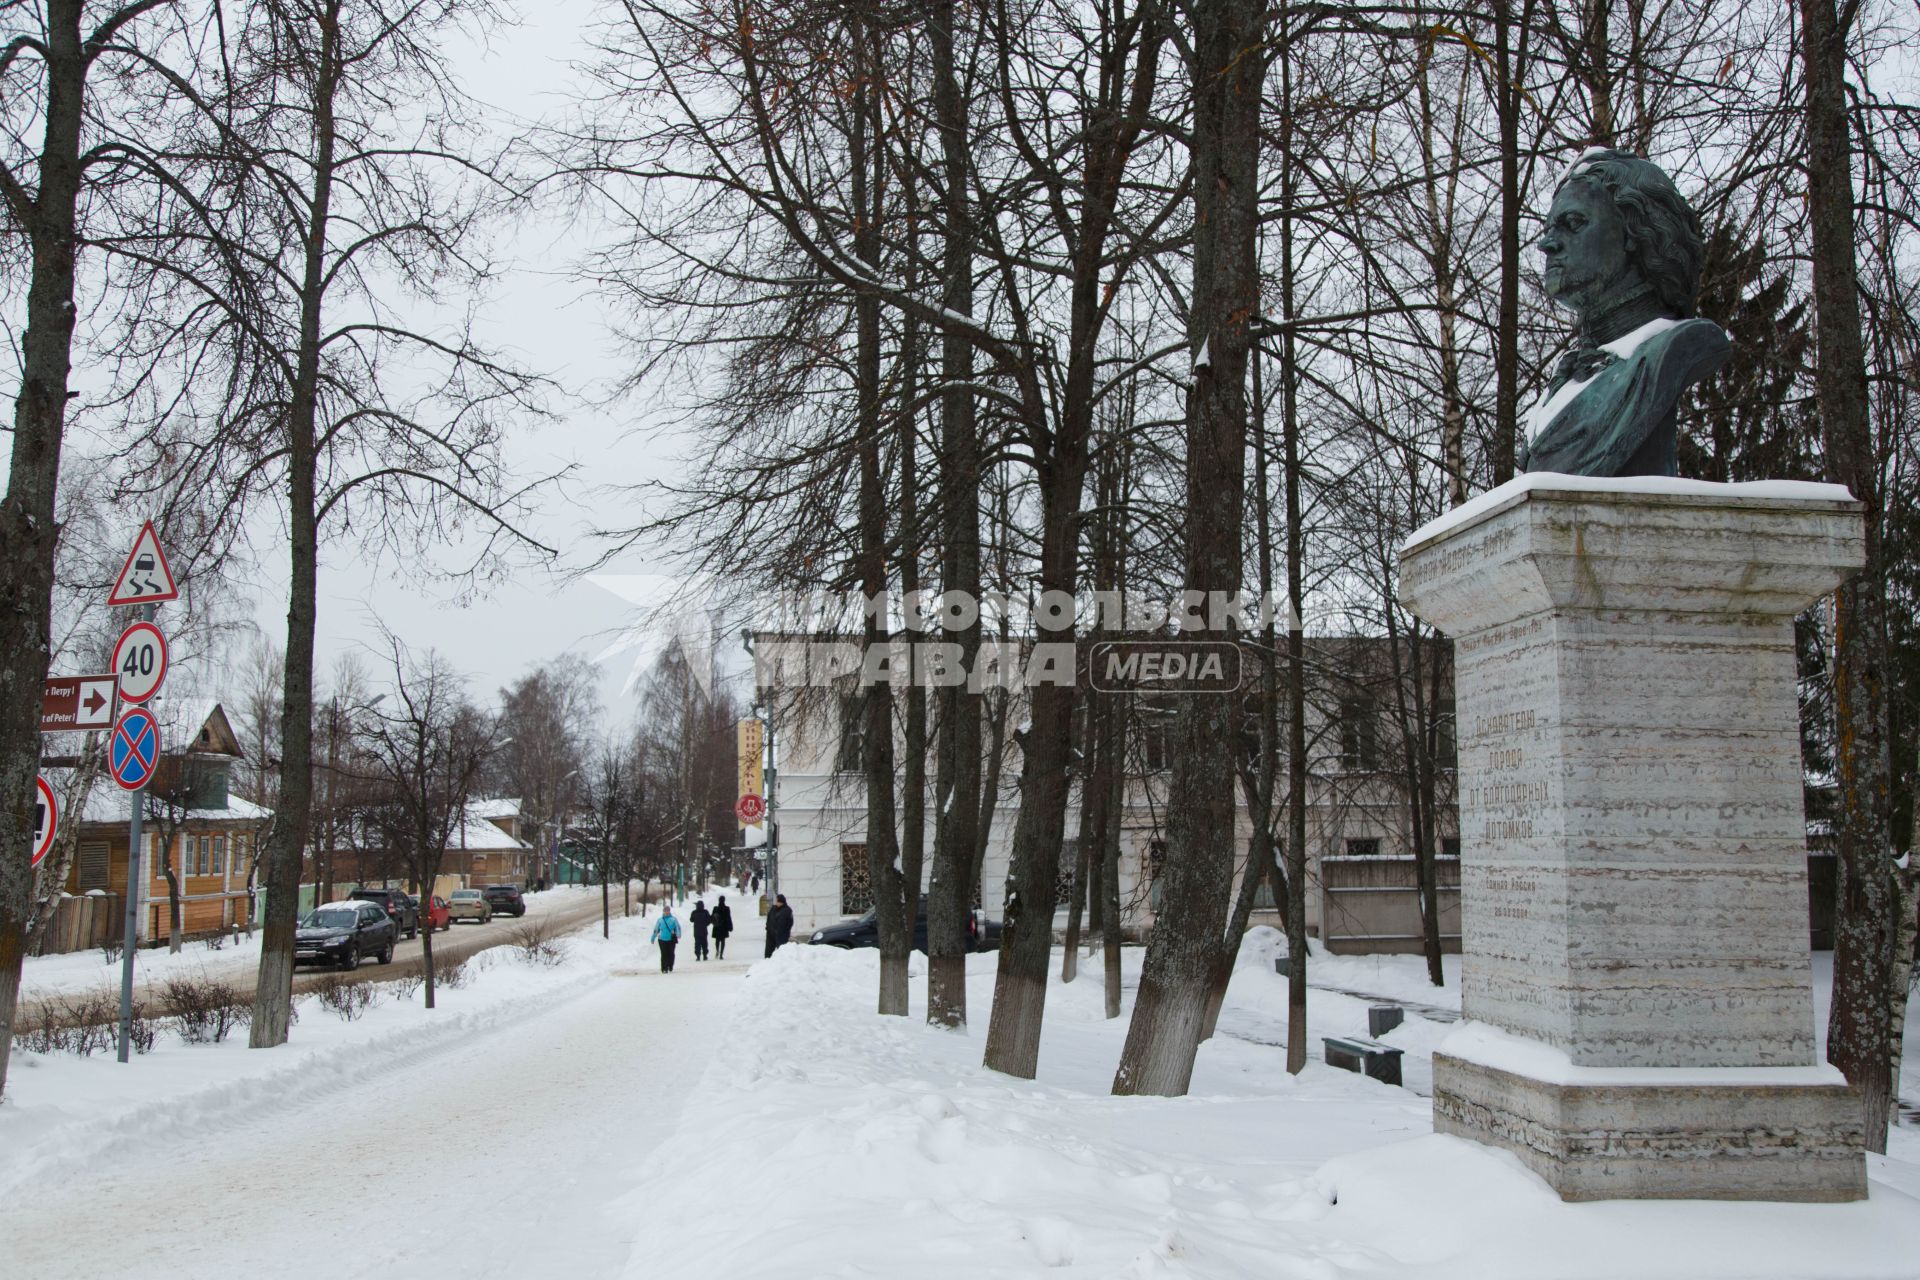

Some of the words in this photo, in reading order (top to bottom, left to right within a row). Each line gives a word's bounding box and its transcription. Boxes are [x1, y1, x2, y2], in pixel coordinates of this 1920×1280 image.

[123, 644, 154, 677] 40
[51, 686, 71, 698] Петру
[46, 714, 54, 723] of
[54, 714, 72, 722] Peter
[1490, 748, 1523, 770] ГОРОДА
[1470, 787, 1480, 806] ОТ
[1484, 781, 1549, 805] БЛАГОДАРНЫХ
[1485, 820, 1533, 840] ПОТОМКОВ
